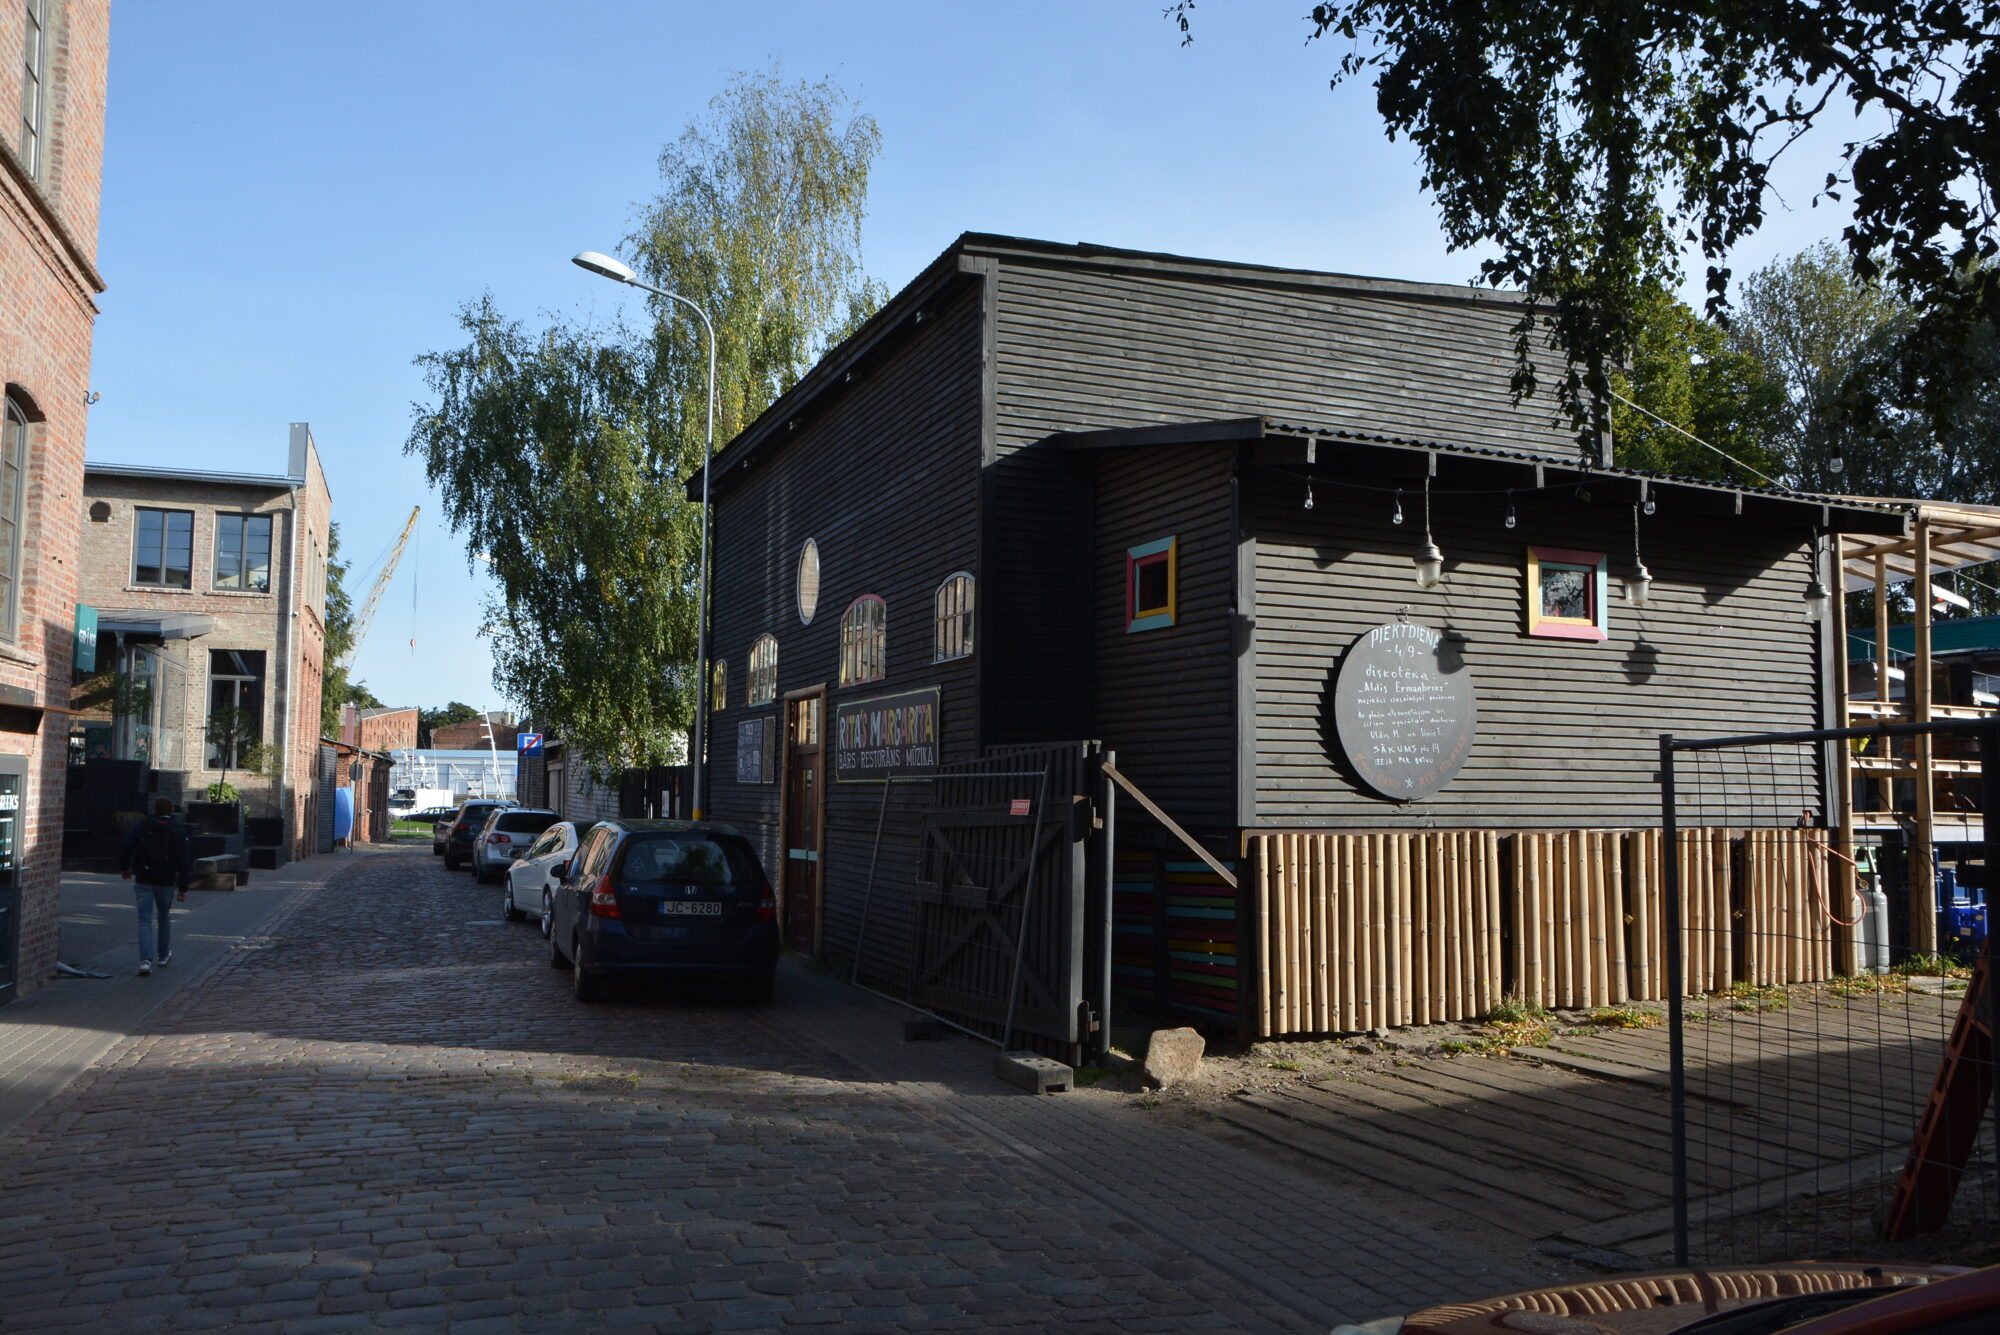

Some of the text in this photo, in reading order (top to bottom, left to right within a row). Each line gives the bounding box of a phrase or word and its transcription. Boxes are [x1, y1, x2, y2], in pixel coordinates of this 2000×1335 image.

[1371, 624, 1440, 649] PIEKTDIENA
[869, 703, 934, 747] MARGARITA
[860, 746, 901, 769] RESTORĀNS
[1373, 743, 1418, 754] SĀKUMS
